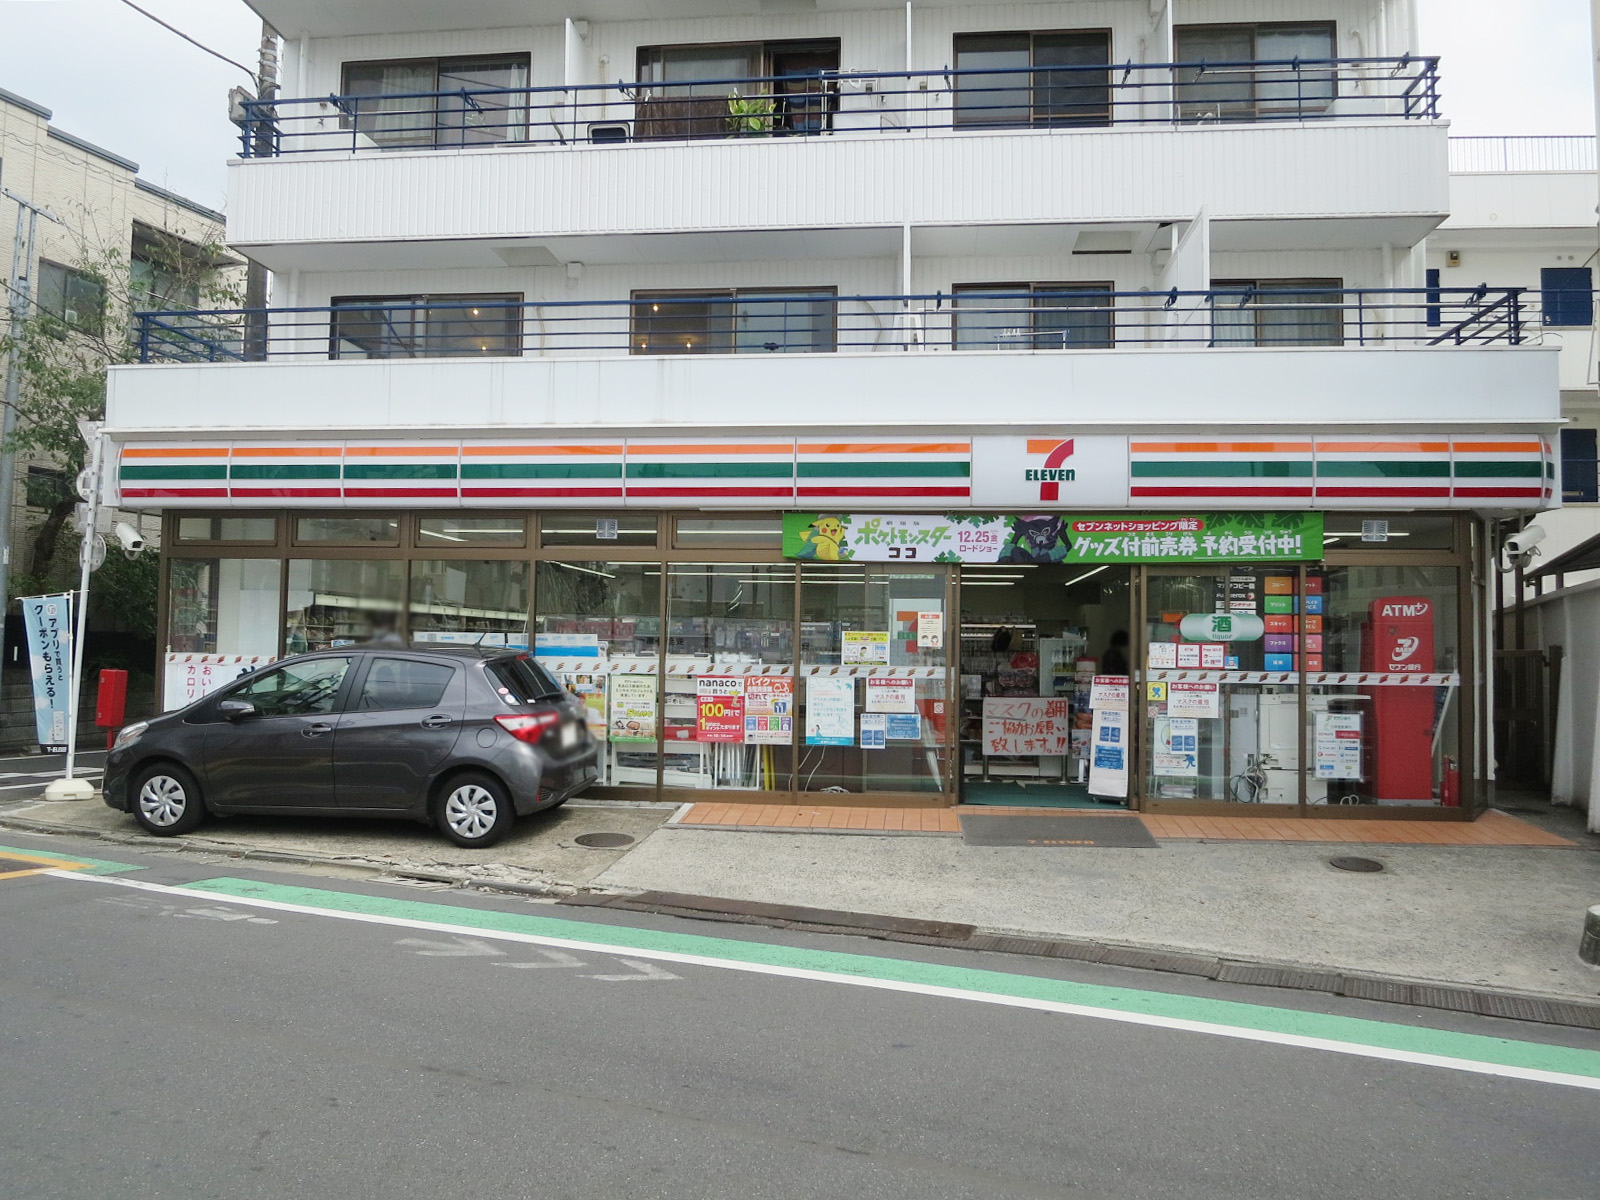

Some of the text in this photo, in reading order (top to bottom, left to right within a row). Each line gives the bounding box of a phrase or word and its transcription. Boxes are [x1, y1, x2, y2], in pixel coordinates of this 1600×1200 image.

[1026, 438, 1074, 500] 7
[854, 517, 952, 548] ポケットモンスター
[1077, 521, 1198, 532] セブンネットショッピング限定
[889, 547, 917, 558] ココ
[1073, 535, 1197, 556] グッズ付前売券
[1212, 616, 1231, 632] 酒
[34, 605, 56, 708] クーポンもらえる!
[49, 618, 63, 681] アプリで買うと
[187, 665, 196, 704] カロリ
[986, 700, 1066, 719] マスクの着用
